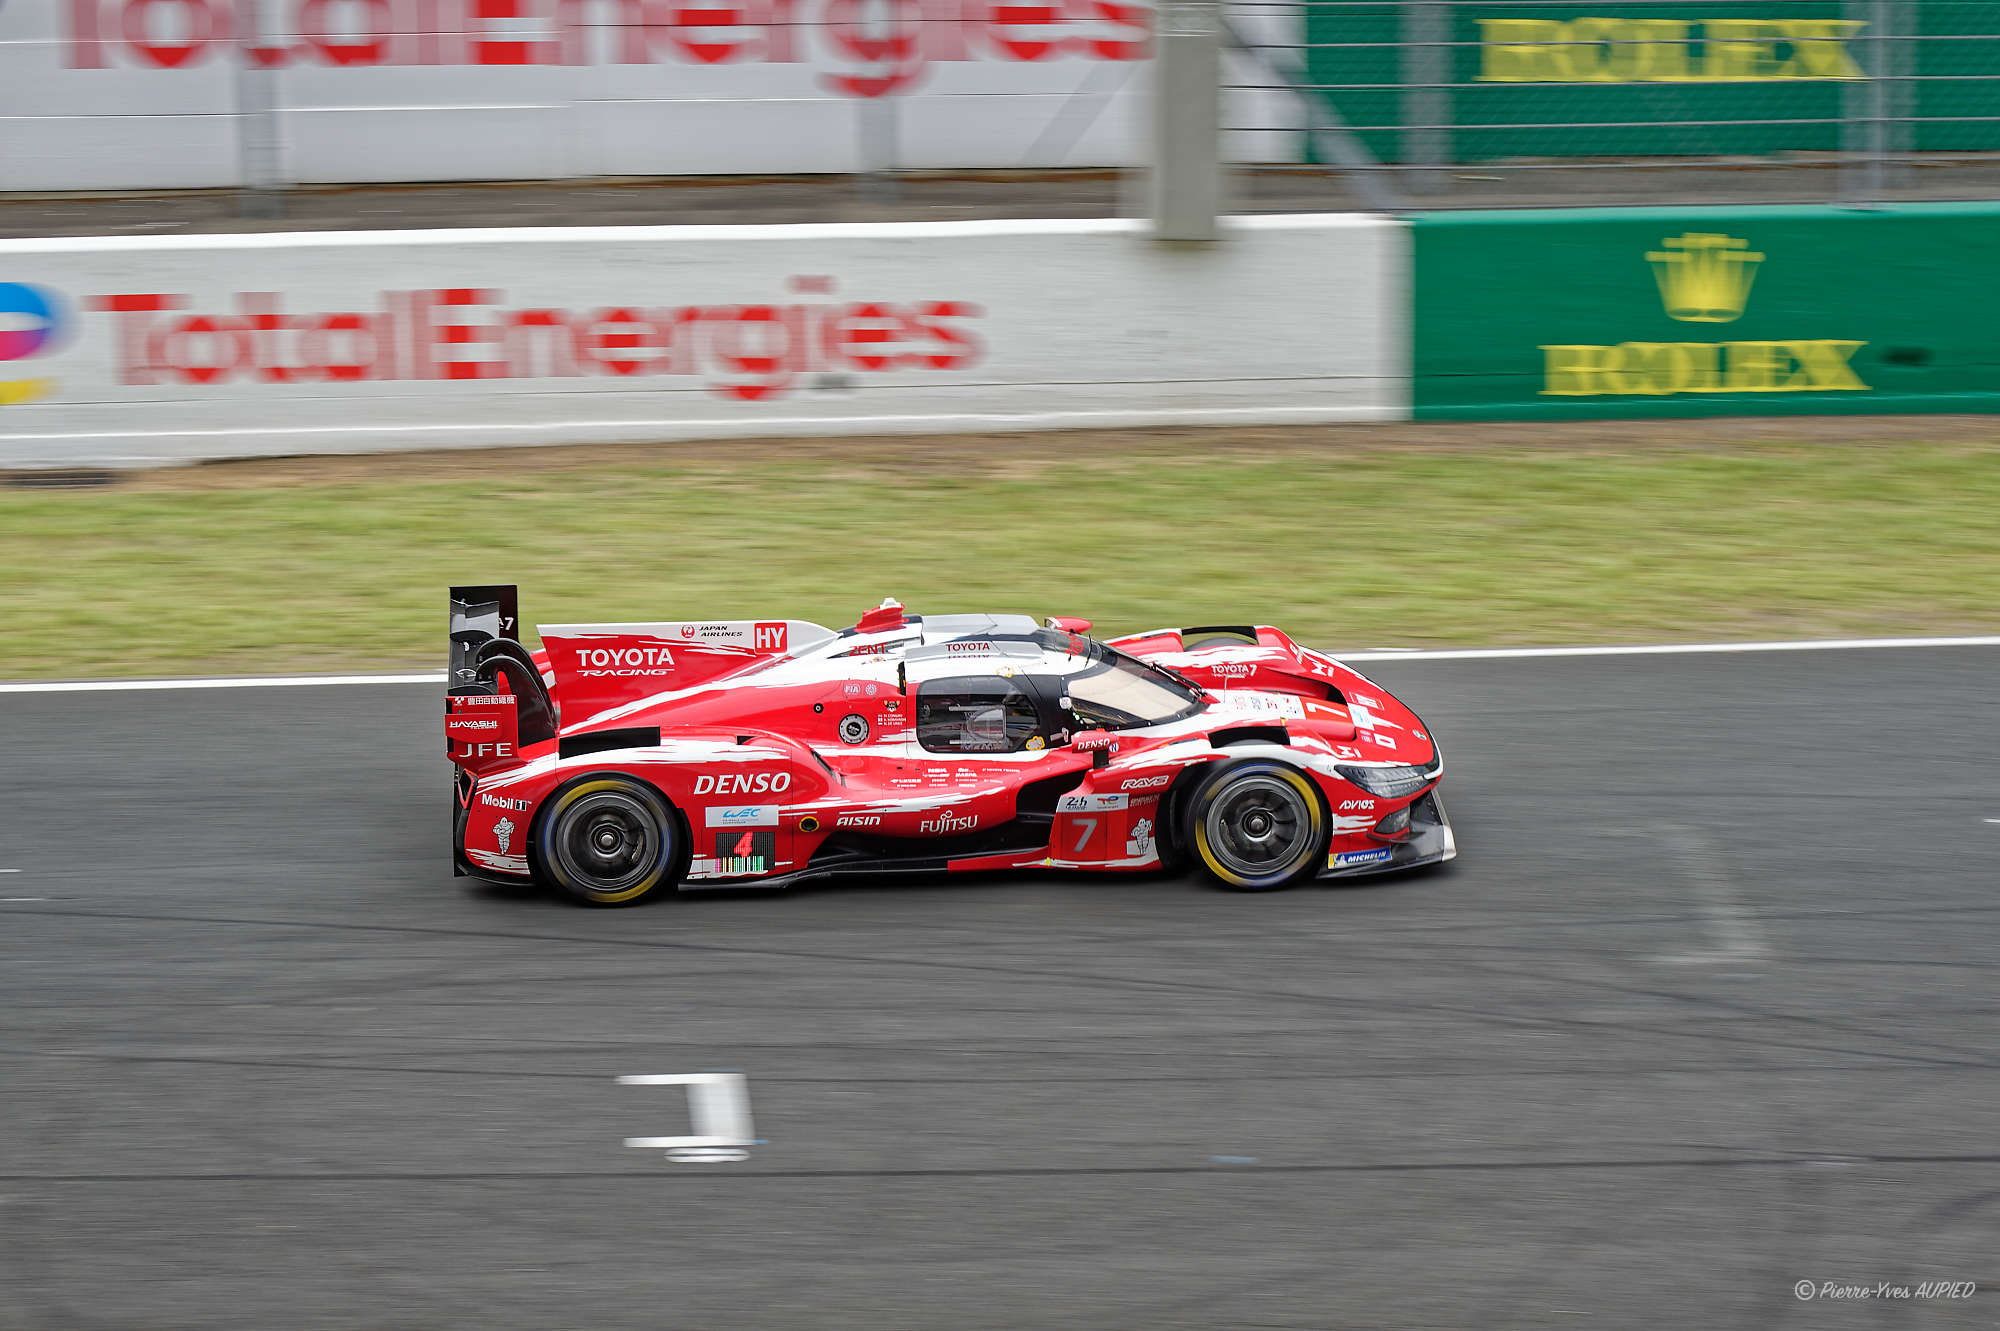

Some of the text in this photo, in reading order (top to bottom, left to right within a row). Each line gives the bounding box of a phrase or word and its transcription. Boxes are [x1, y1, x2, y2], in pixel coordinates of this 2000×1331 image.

[1473, 17, 1872, 83] ROLEX
[85, 275, 988, 400] TotalEnergies
[1538, 340, 1871, 396] ROLEX
[756, 627, 785, 648] HY
[945, 642, 990, 652] TOYOTA
[575, 648, 675, 667] TOYOTA
[576, 669, 675, 677] RACING
[1211, 664, 1250, 675] TOYOTA
[449, 720, 498, 729] HAYASHI
[459, 743, 513, 757] JFE
[1077, 737, 1111, 751] DENSO
[693, 772, 791, 795] DENSO
[1120, 775, 1169, 790] RAYS
[481, 793, 514, 810] Mobil
[722, 808, 761, 818] WEC
[836, 815, 881, 827] AISIN
[919, 810, 979, 834] FUJITSU
[1072, 818, 1098, 853] 7
[733, 831, 754, 858] 4
[1347, 850, 1387, 863] MICHELIN
